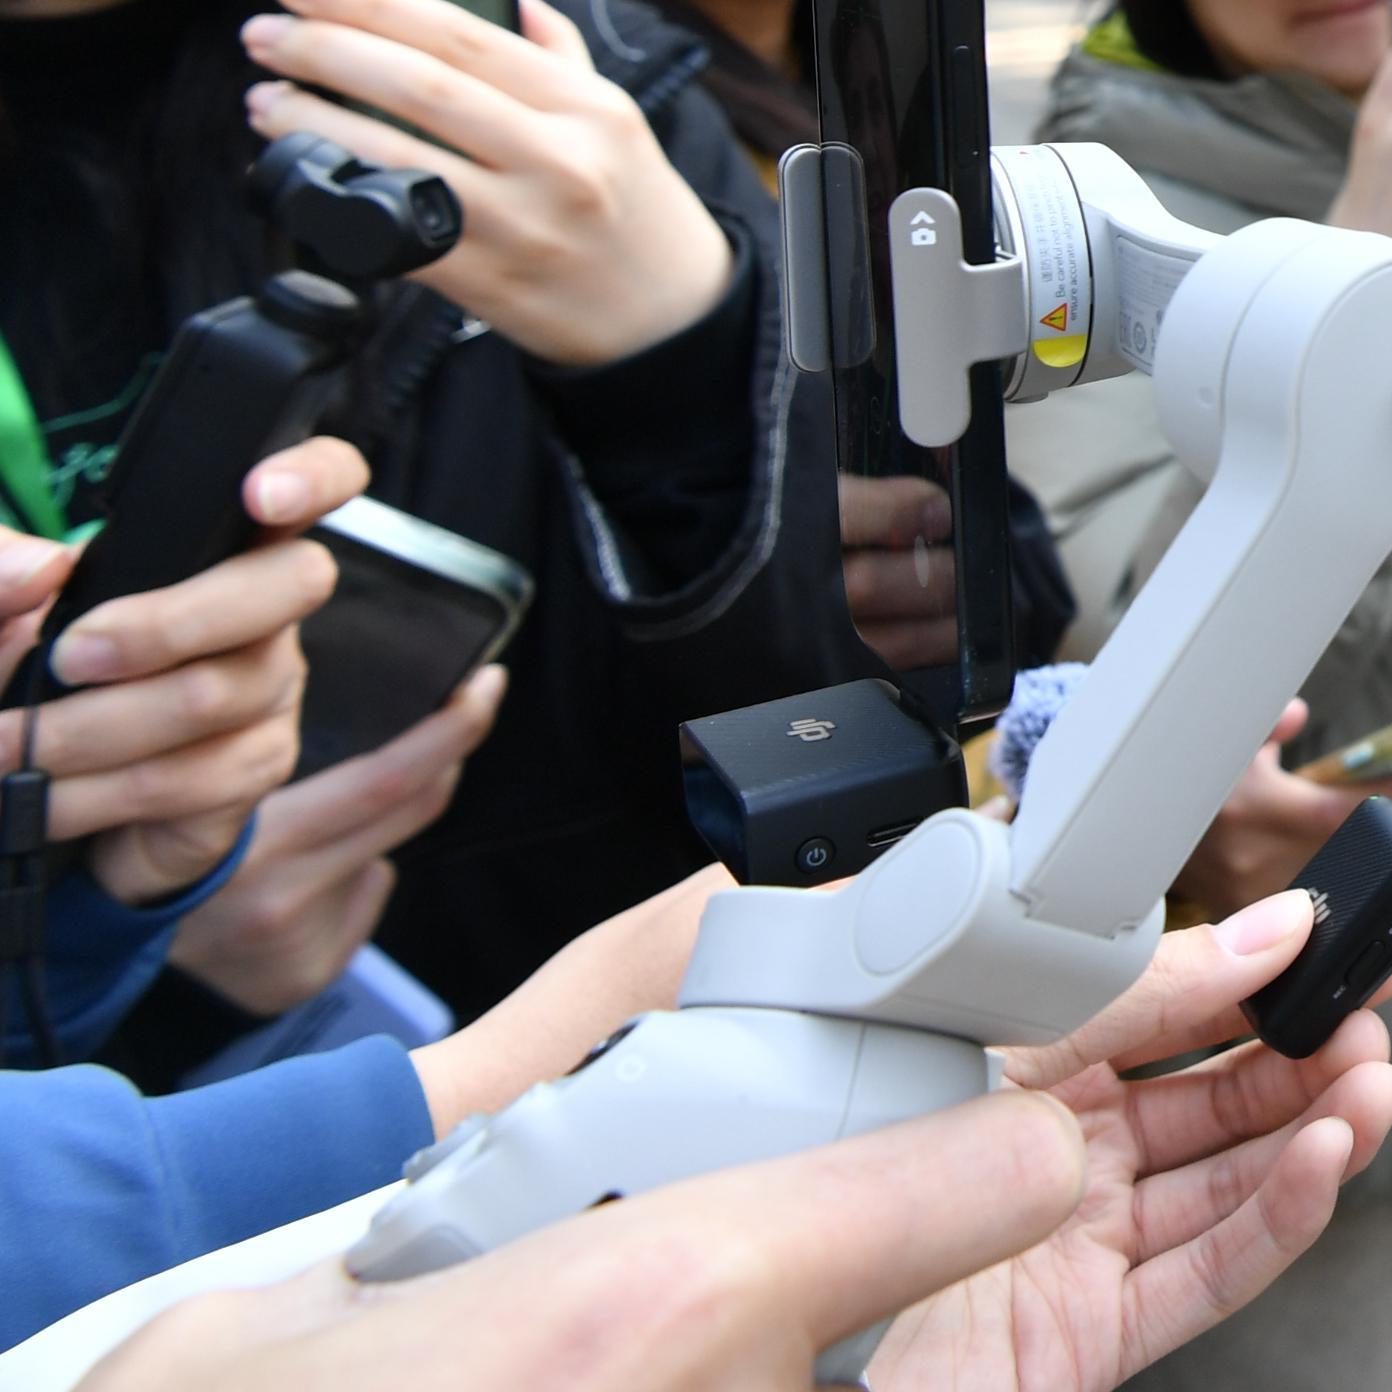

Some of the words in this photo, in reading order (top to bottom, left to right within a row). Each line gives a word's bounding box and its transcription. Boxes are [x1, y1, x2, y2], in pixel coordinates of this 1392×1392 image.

[1053, 247, 1065, 282] careful
[1067, 244, 1078, 285] accurate
[1056, 284, 1066, 298] Be
[1070, 287, 1078, 321] ensure
